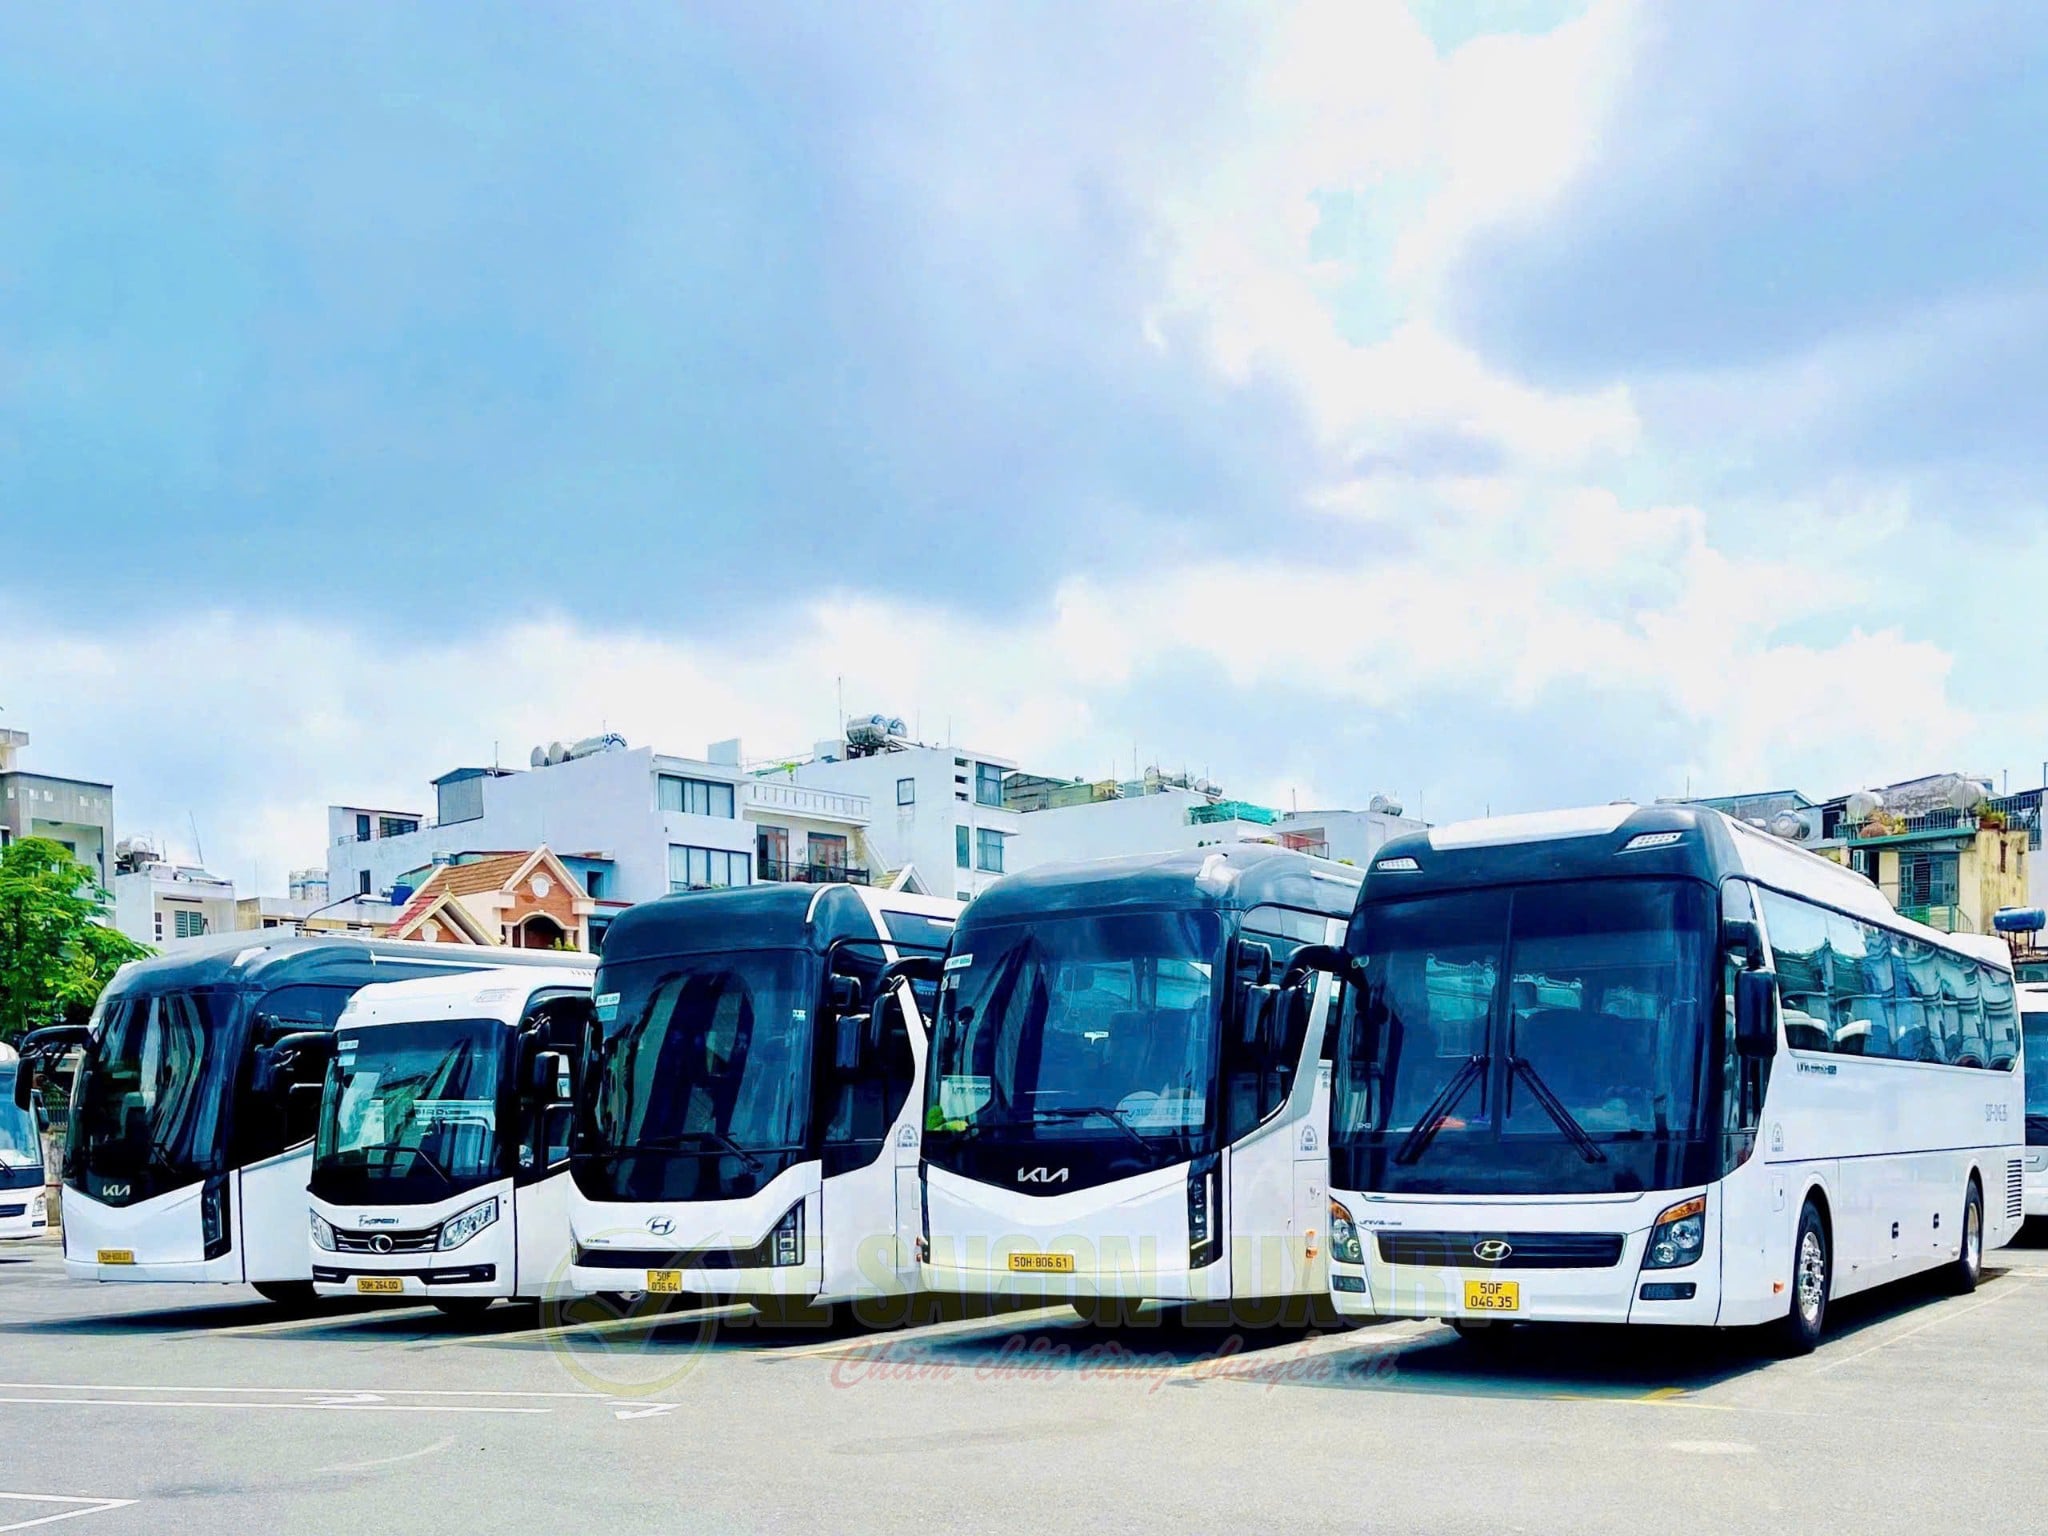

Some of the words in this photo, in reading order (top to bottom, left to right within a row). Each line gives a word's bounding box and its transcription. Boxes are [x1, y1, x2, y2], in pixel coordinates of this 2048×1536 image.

[1017, 1167, 1069, 1183] KIA
[102, 1184, 131, 1196] KIA
[656, 1271, 671, 1282] 50F
[1480, 1282, 1503, 1295] 50F
[1470, 1295, 1513, 1308] 046.35
